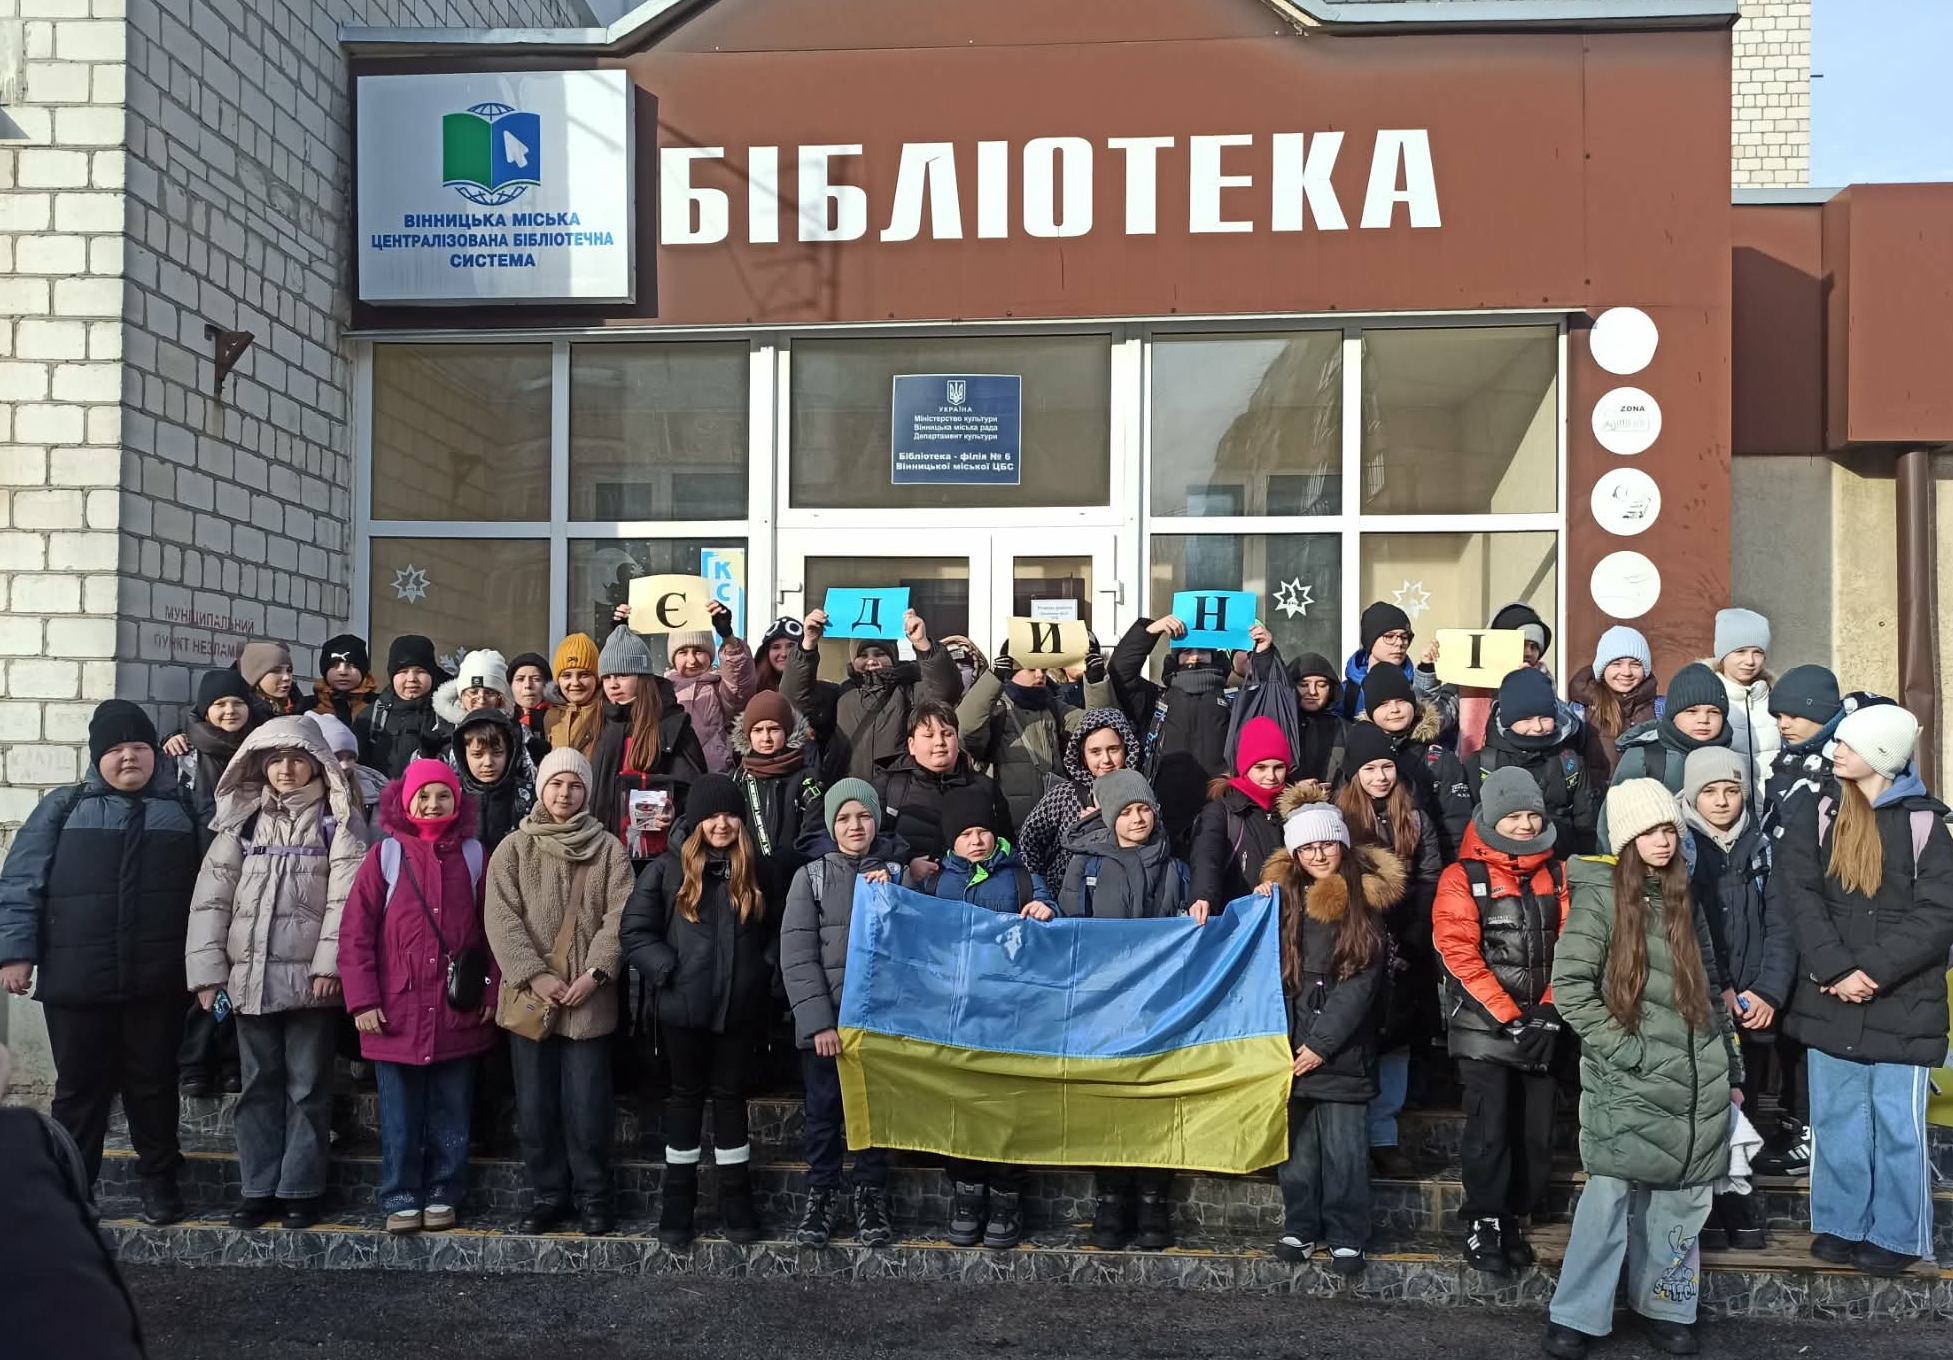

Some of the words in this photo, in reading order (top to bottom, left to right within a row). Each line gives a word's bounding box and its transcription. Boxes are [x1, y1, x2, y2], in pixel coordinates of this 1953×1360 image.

[658, 127, 1443, 246] БІБЛІОТЕКА
[403, 213, 507, 230] ВІННИЦЬКА
[512, 212, 581, 227] МІСЬКА
[371, 232, 509, 250] ЦЕНТРАЛІЗОВАНА
[513, 231, 614, 248] БІБЛІОТЕЧНА
[450, 253, 536, 268] СИСТЕМА
[938, 405, 973, 413] УКРАЇНА
[1620, 405, 1646, 413] ZONA
[914, 415, 962, 424] Міністерство
[963, 416, 998, 424] культури
[913, 424, 952, 432] Вінницька
[954, 424, 979, 432] міська
[980, 424, 998, 433] рада
[913, 433, 962, 441] Департамент
[964, 433, 998, 441] культури
[898, 452, 952, 461] Бібліотека
[960, 452, 987, 461] філія
[990, 452, 1002, 461] №
[1004, 452, 1011, 461] 6
[895, 462, 950, 471] Вінницької
[953, 462, 990, 471] міської
[992, 462, 1015, 472] ЦБС
[164, 605, 255, 635] МУНІЦИПАЛЬНИЙ
[655, 591, 688, 629] Є
[851, 597, 882, 635] Д
[1028, 621, 1065, 654] И
[1191, 595, 1231, 632] Н
[1465, 633, 1487, 669] І
[153, 633, 190, 653] ПУНКТ
[1653, 1278, 1698, 1302] STITCH
